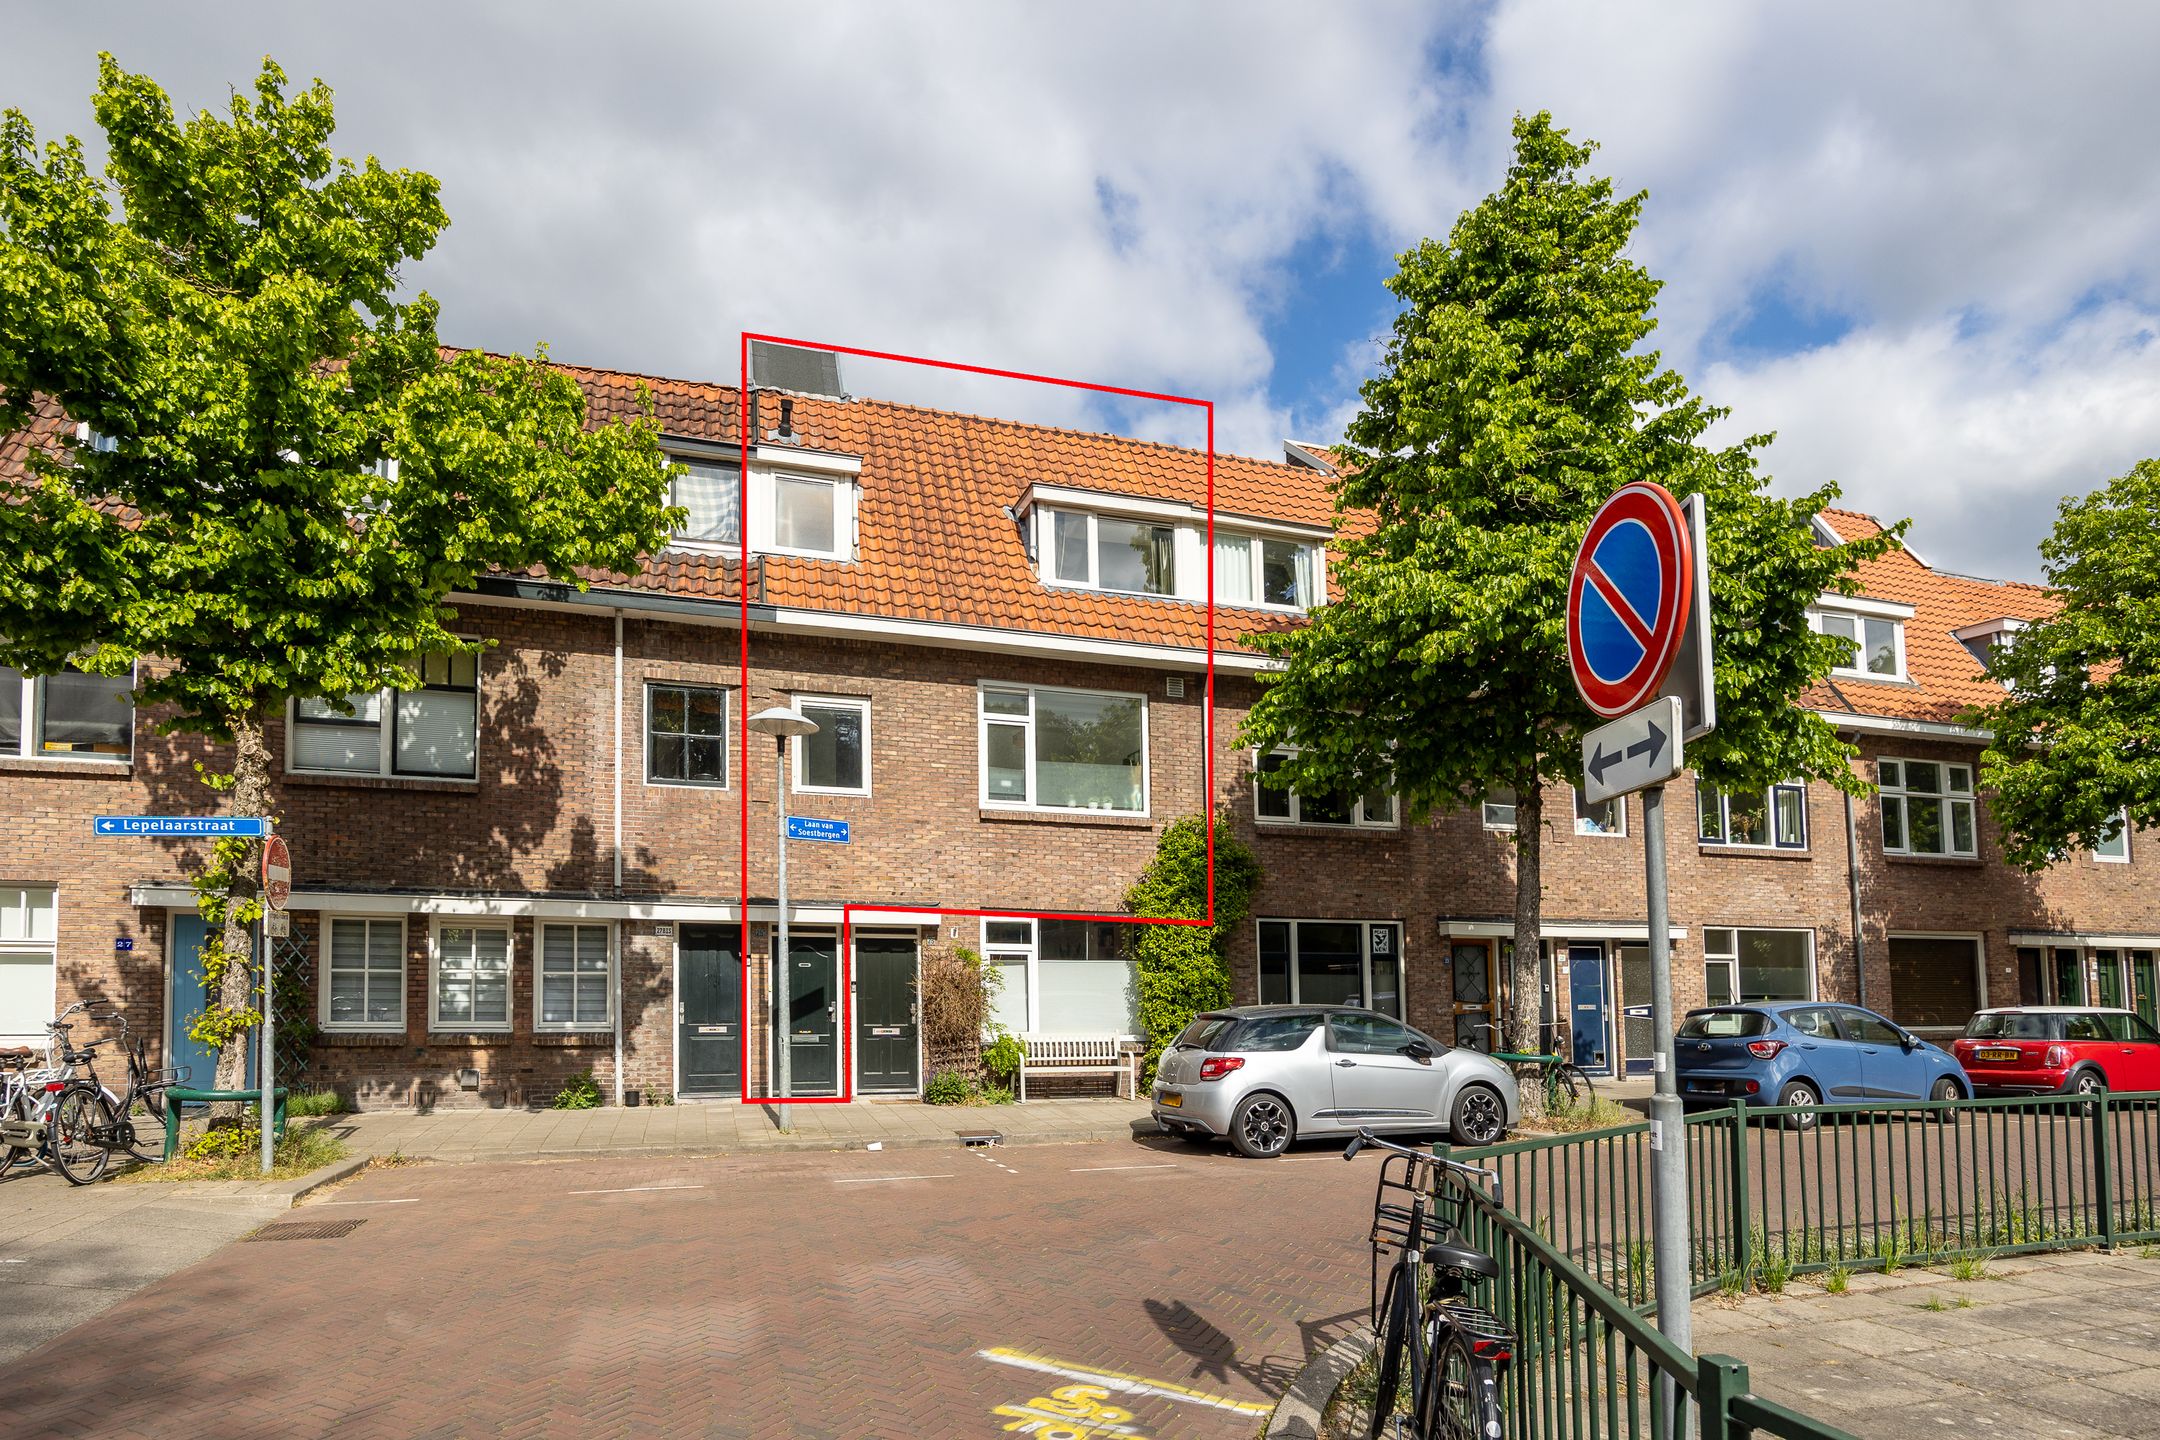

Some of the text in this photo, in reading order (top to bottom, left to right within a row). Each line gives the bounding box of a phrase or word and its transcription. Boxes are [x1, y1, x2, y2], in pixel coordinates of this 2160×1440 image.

[123, 819, 235, 832] Lepelaarstraat
[804, 820, 820, 828] Laan
[797, 828, 841, 840] Soestbergen
[116, 940, 132, 948] 27
